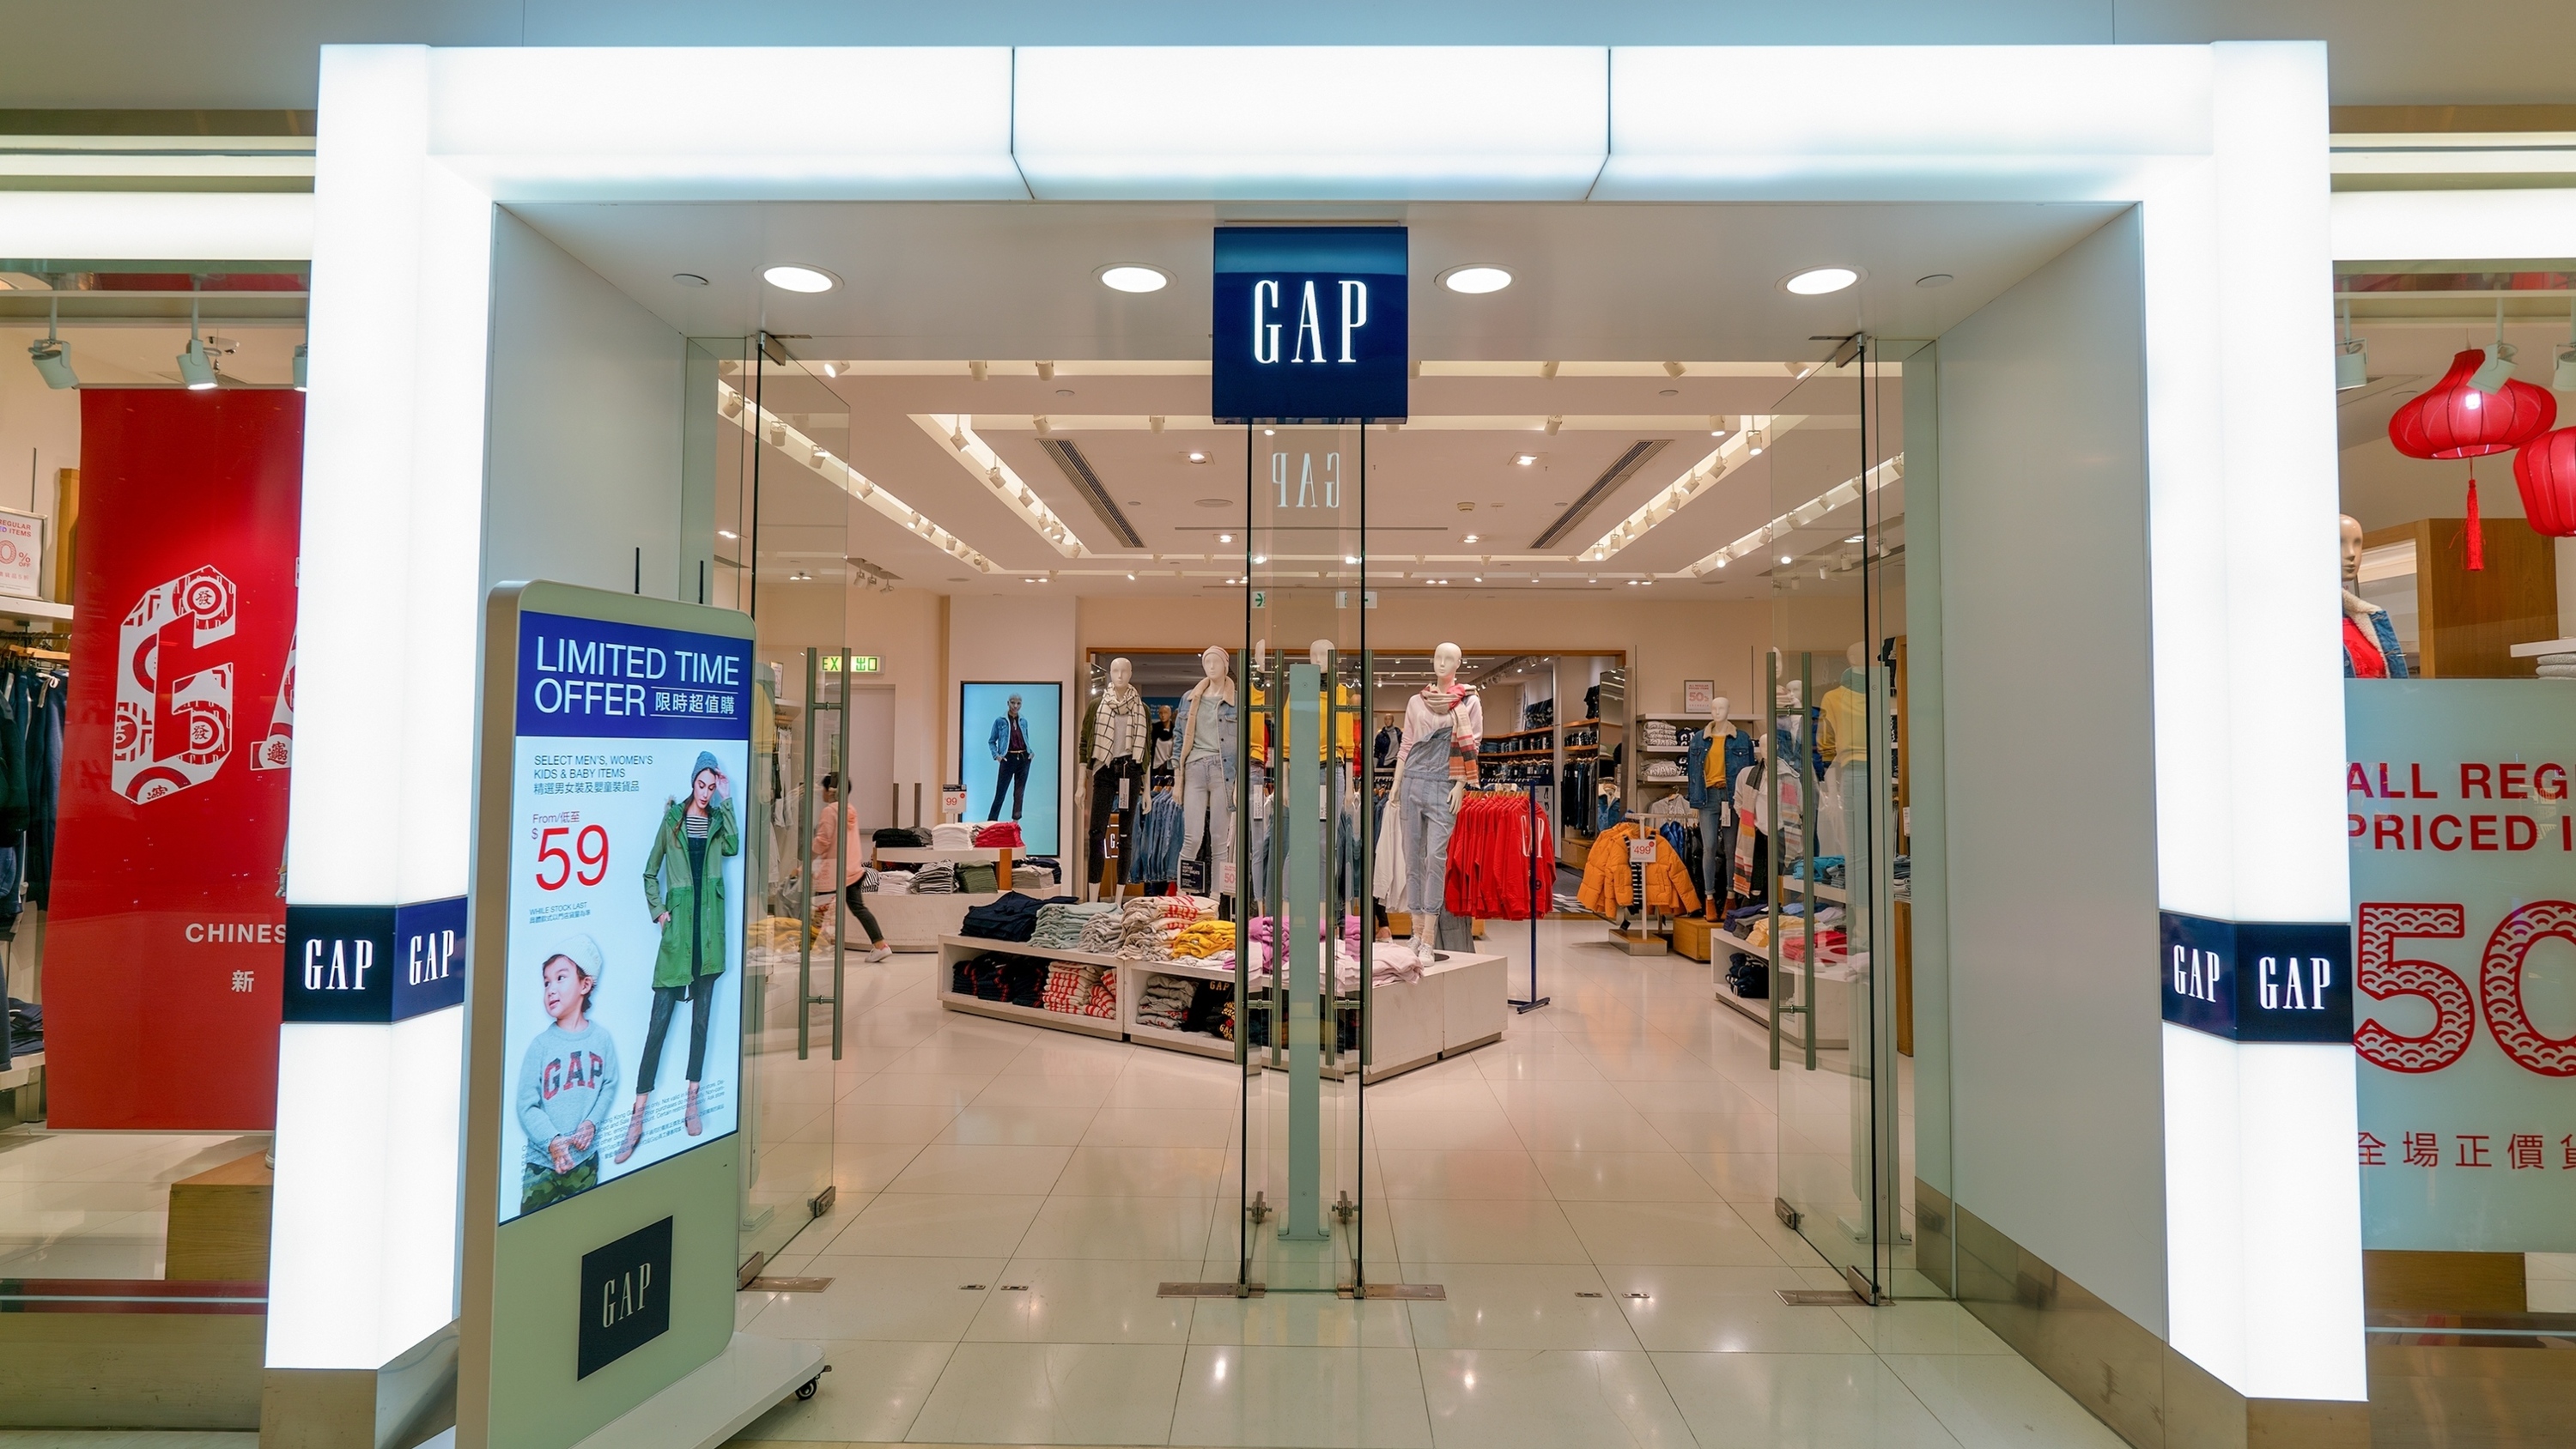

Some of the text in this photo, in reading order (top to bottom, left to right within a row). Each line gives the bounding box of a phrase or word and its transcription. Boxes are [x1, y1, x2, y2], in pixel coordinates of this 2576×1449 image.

[1254, 280, 1368, 364] GAP
[538, 636, 667, 680] LIMITED
[675, 651, 739, 686] TIME
[855, 658, 878, 671] 出口
[534, 678, 645, 717] OFFER
[655, 692, 735, 715] 限時超值購
[534, 755, 653, 765] SELECT MEN'S, WOMEN'S
[534, 768, 625, 779] KIDS & BABY ITEMS
[2347, 762, 2438, 799] ALL
[532, 824, 609, 891] $ 59
[550, 904, 572, 913] STOCK
[573, 901, 588, 911] LAST
[304, 930, 454, 991] GAP GAP
[2173, 944, 2330, 1009] GAP GAP
[231, 969, 254, 992] 新
[1209, 980, 1230, 991] GAP
[544, 1051, 603, 1100] GAP
[603, 1262, 652, 1328] GAP
